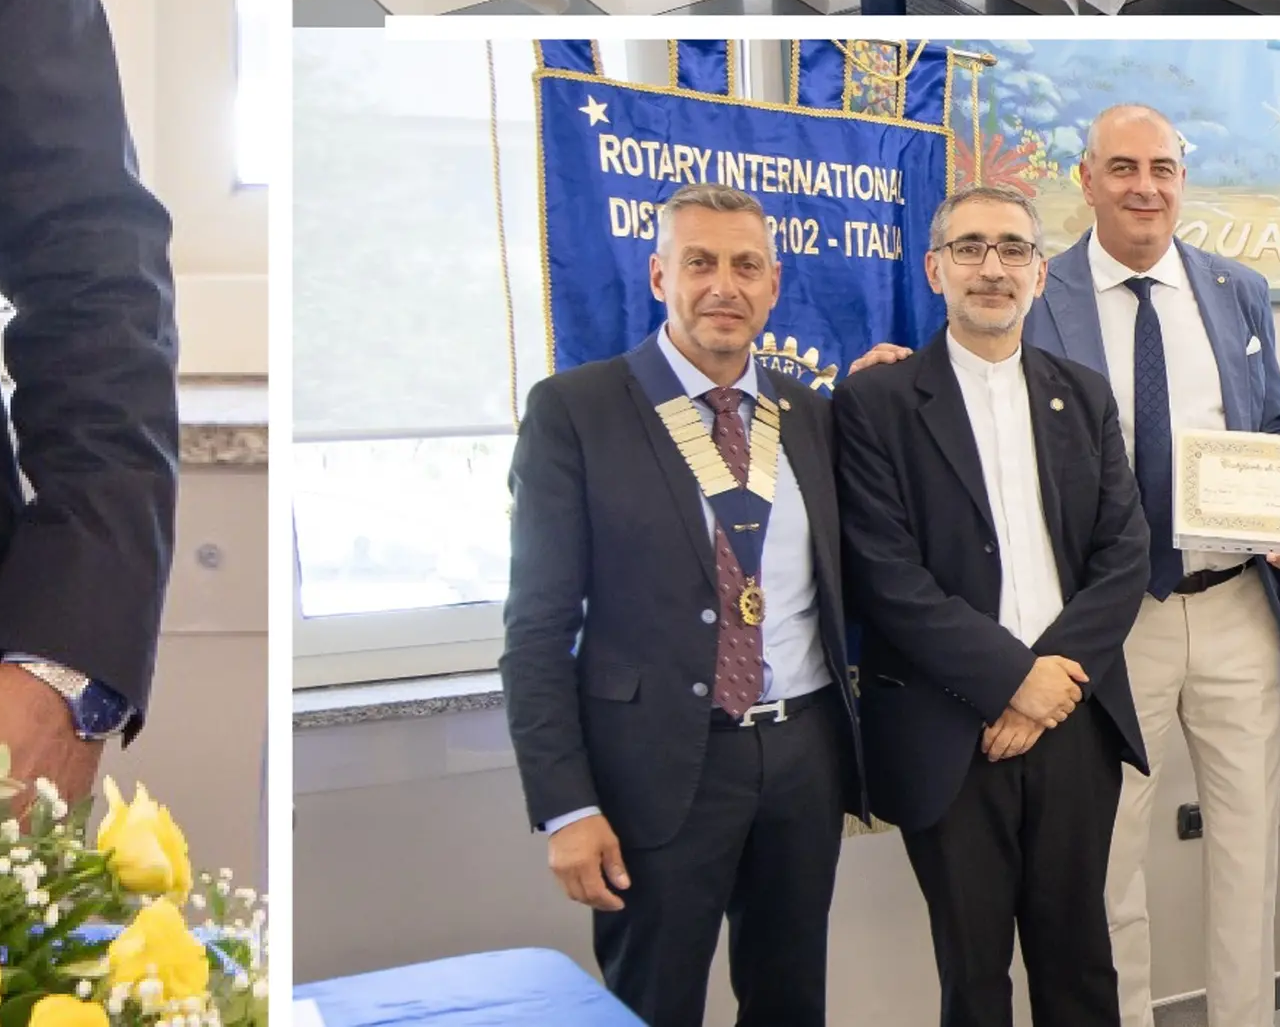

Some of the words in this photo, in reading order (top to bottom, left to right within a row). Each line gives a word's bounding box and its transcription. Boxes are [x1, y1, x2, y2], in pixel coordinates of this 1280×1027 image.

[598, 133, 712, 185] ROTARY
[717, 150, 905, 205] INTERNATIONAL
[845, 221, 903, 261] ITALIA
